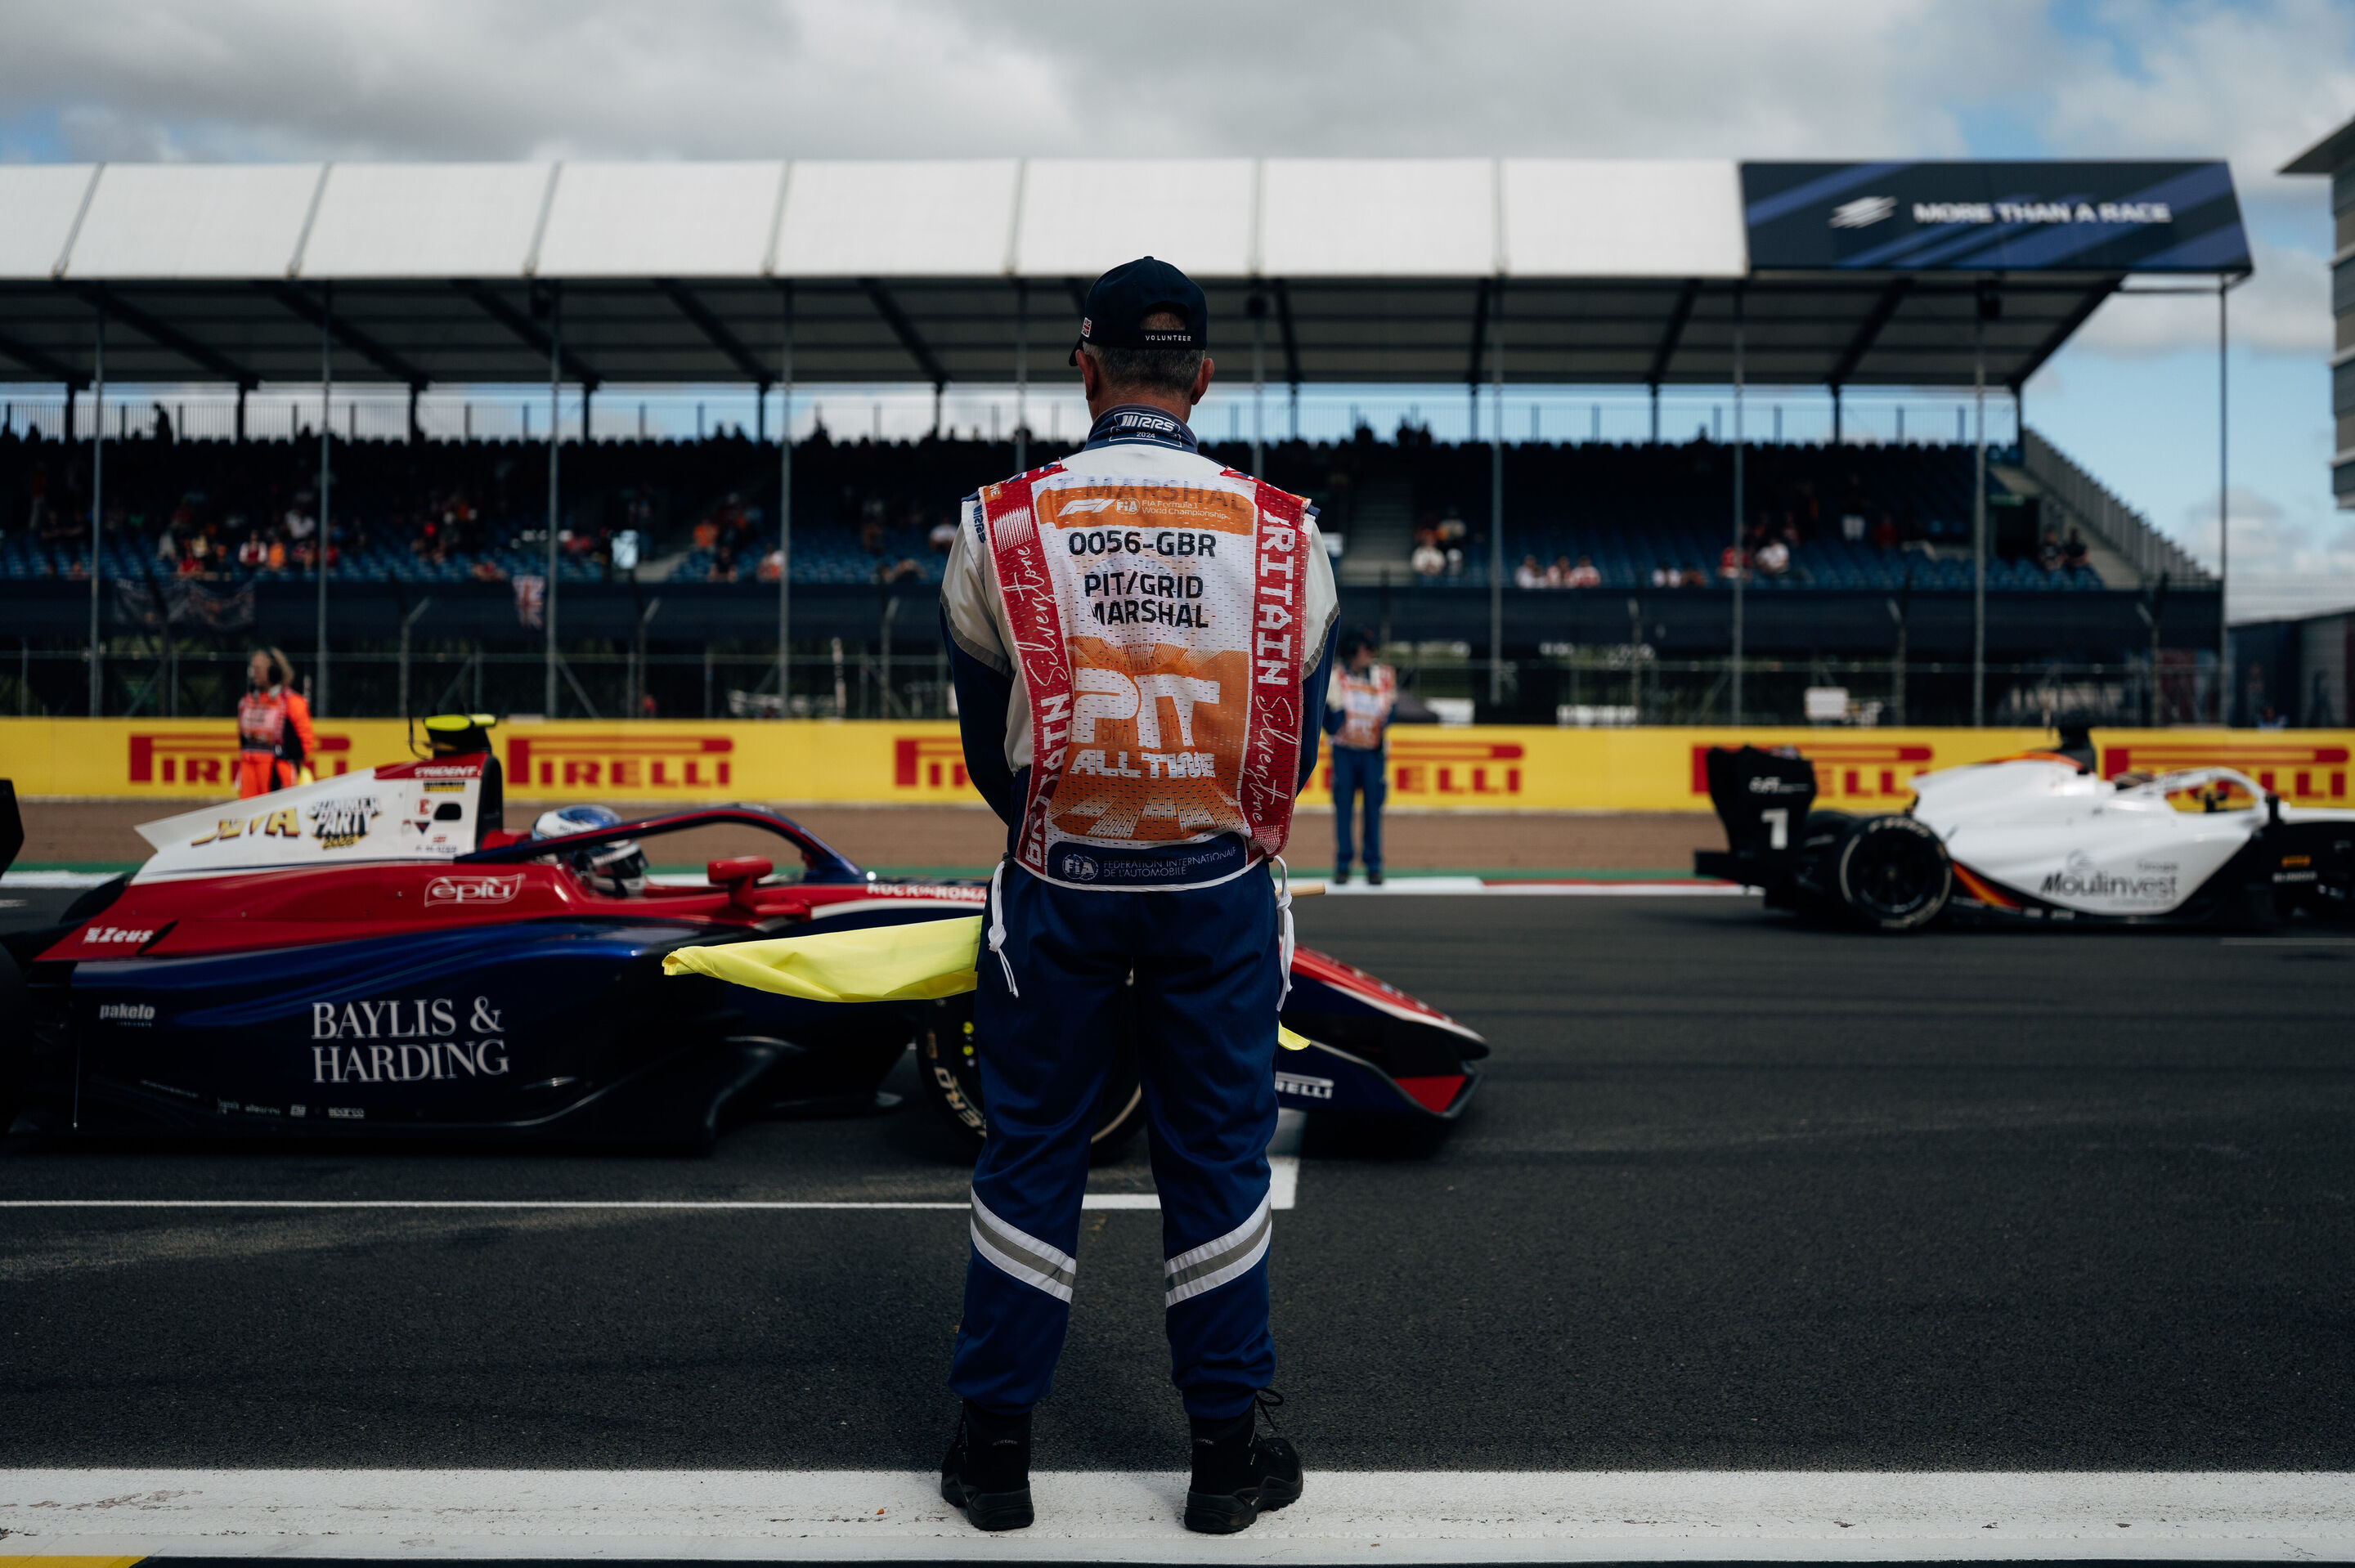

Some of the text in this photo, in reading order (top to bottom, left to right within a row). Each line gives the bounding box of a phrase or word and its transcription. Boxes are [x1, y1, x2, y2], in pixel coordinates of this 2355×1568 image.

[1913, 203, 2172, 223] MORE THAN A RACE
[1158, 500, 1193, 509] Formula
[1168, 508, 1228, 520] Championship
[1068, 530, 1217, 558] 0056-GBR
[1084, 571, 1204, 599] PIT/GRID
[1003, 545, 1068, 686] Silverstone
[1070, 666, 1221, 750] PIT
[414, 766, 477, 777] TRIDENT
[507, 734, 733, 786] PIRELLI
[1069, 750, 1142, 778] ALL
[1244, 695, 1299, 824] Silverstone
[310, 797, 381, 818] SUMMER
[312, 812, 373, 836] PARTY
[1761, 808, 1788, 850] 1
[1104, 858, 1164, 869] FEDERATION
[1104, 867, 1186, 877] DE L'AUTOMOBILE
[866, 884, 919, 897] ROCK
[2040, 871, 2178, 898] Moulinvest
[98, 927, 154, 943] Zeus
[99, 1003, 155, 1019] pakelo
[312, 996, 505, 1039] BAYLIS &
[312, 1039, 509, 1083] HARDING
